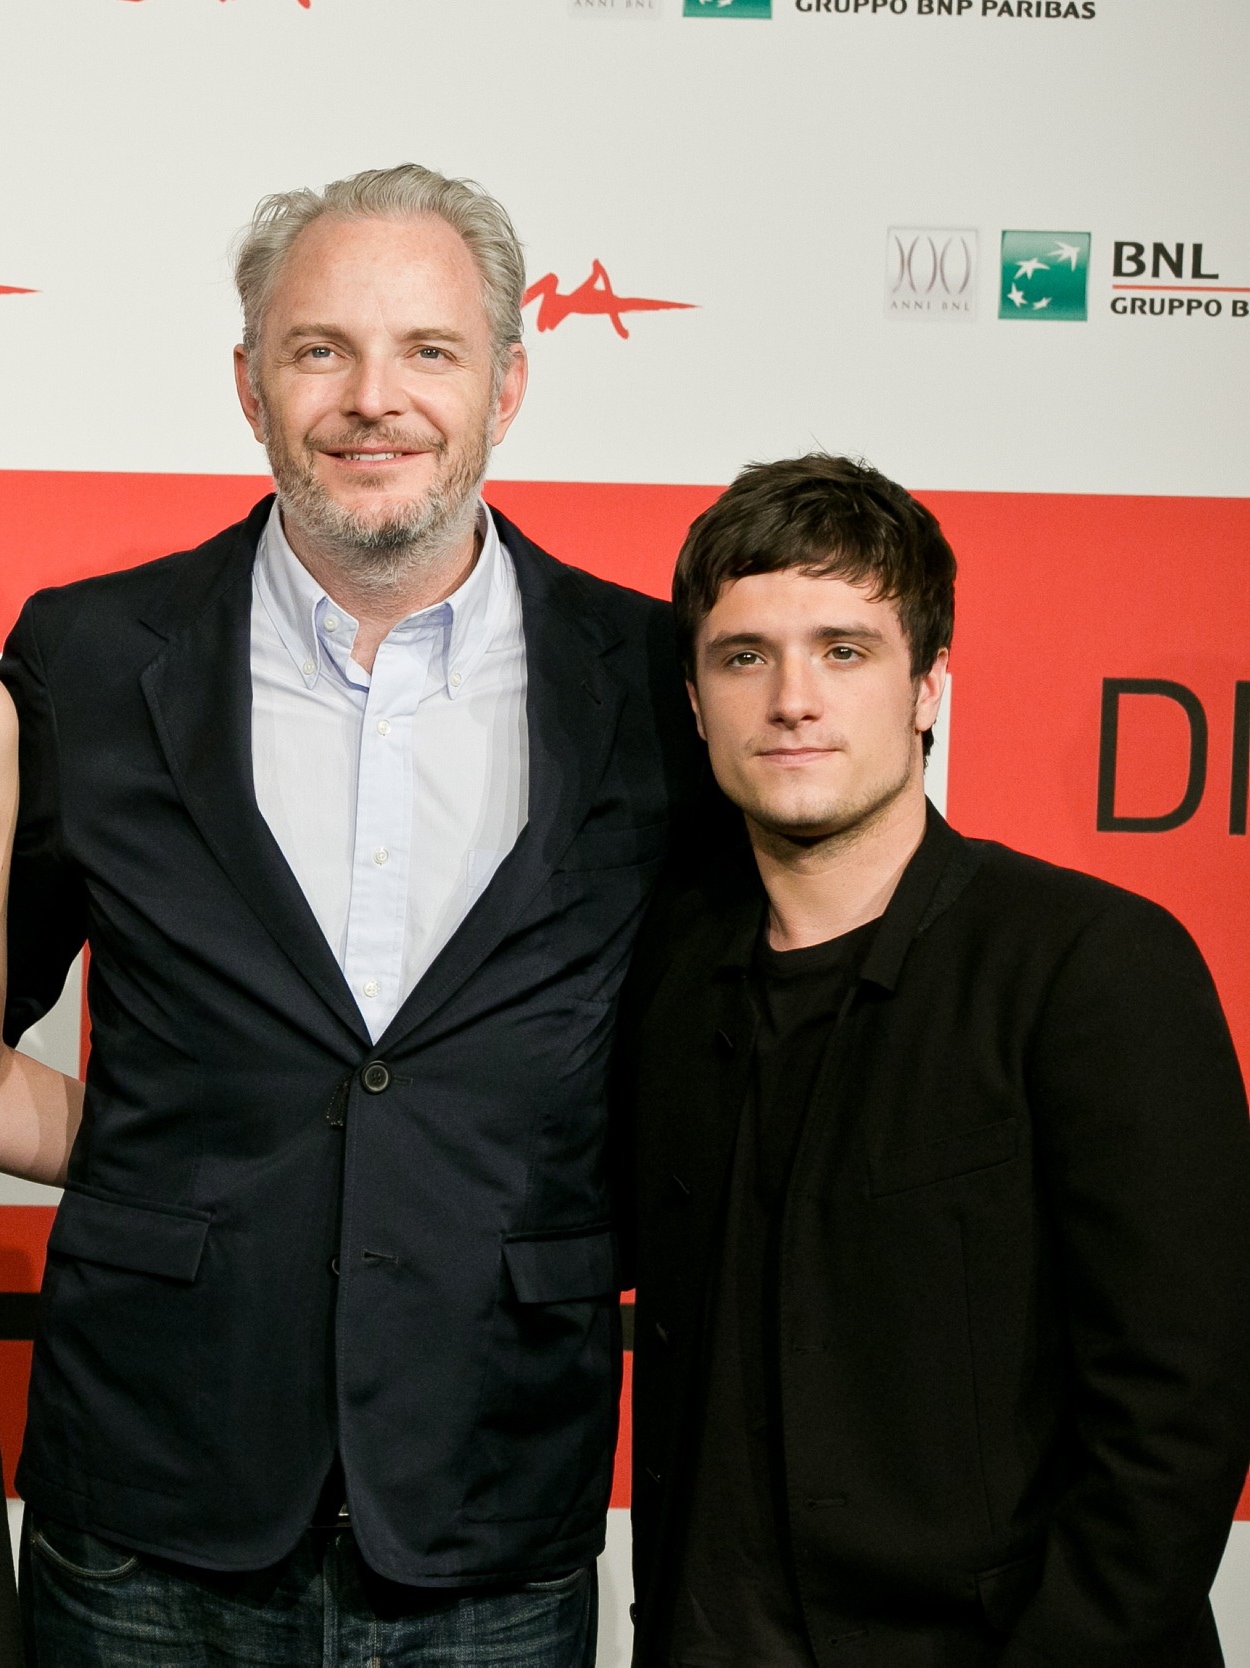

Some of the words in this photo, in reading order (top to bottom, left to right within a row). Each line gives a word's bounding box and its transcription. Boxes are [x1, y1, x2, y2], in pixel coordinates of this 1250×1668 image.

[795, 0, 908, 14] GRUPPO
[917, 0, 974, 16] BNP
[980, 0, 1097, 19] PARIBAS
[1112, 241, 1220, 280] BNL
[890, 300, 931, 311] ANNI
[1110, 296, 1223, 317] GRUPPO
